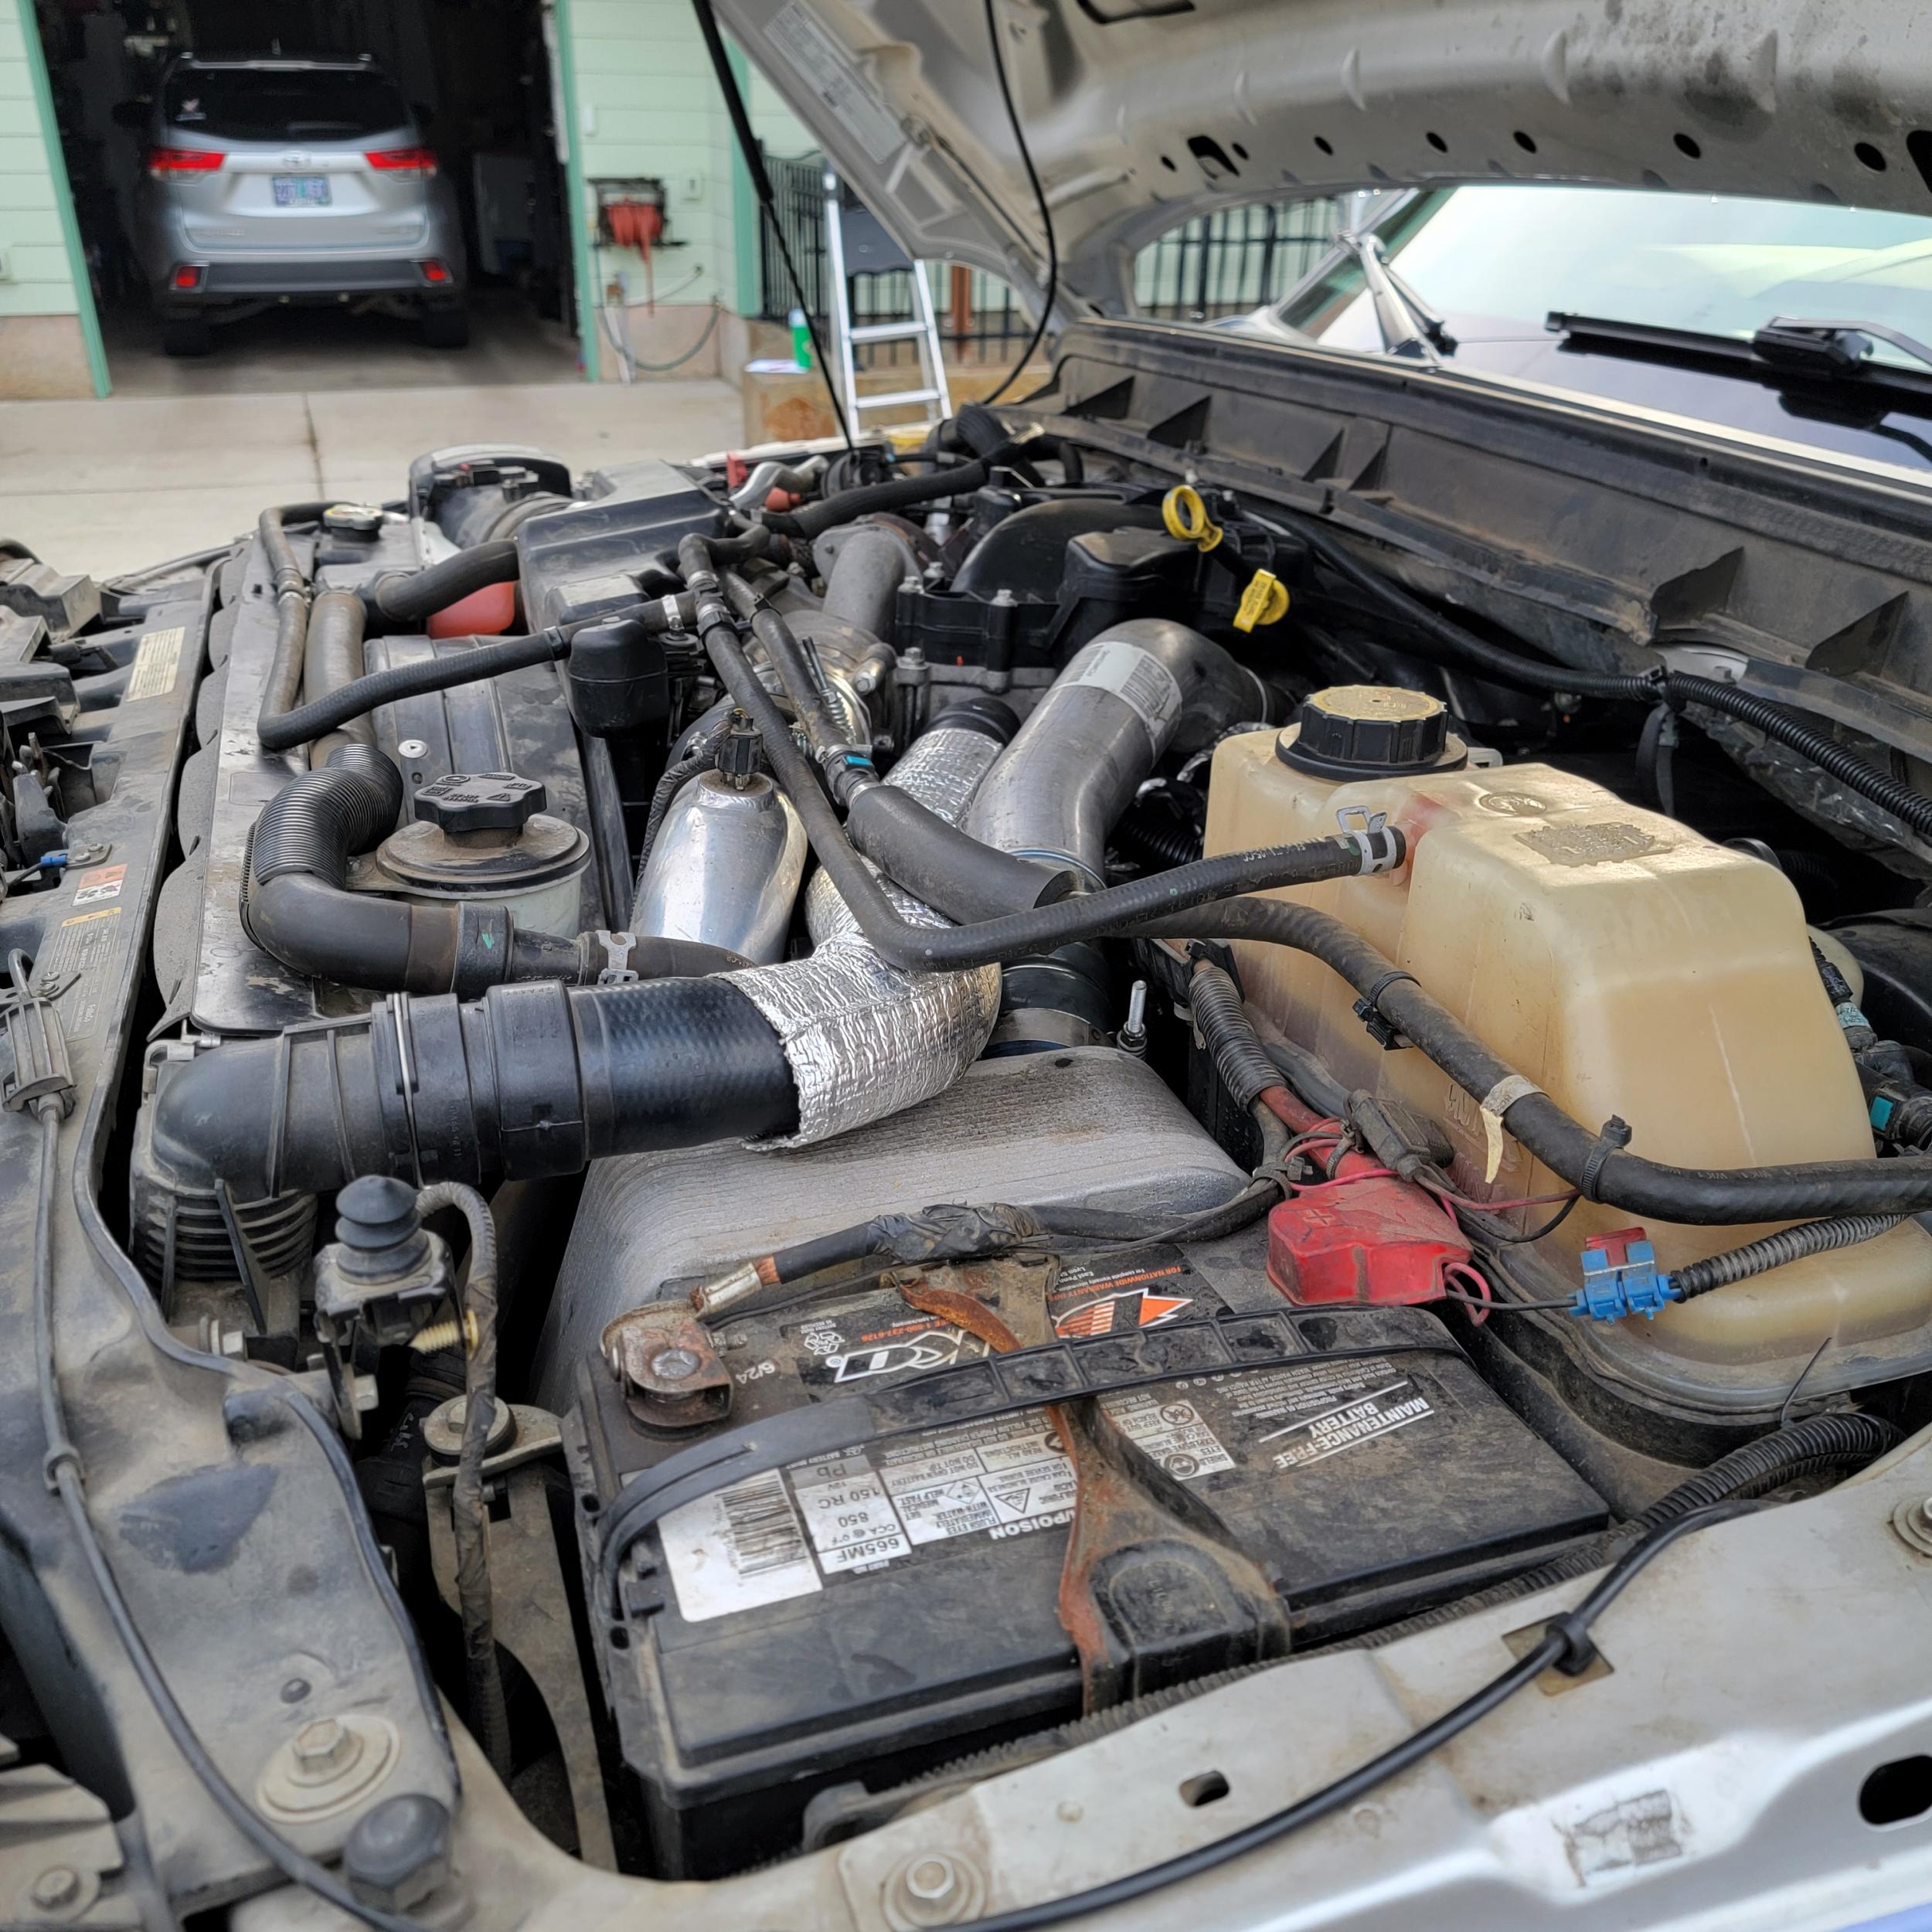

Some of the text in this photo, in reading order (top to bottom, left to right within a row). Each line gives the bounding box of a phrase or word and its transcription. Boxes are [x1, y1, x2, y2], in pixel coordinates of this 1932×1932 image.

[1165, 1266, 1181, 1274] FOR
[1059, 1275, 1077, 1284] Penn
[1115, 1270, 1165, 1285] NATIONWIDE
[1066, 1282, 1113, 1297] WARRANTY
[737, 1362, 775, 1385] 6/24
[1306, 1401, 1379, 1437] BATTERY
[1270, 1396, 1430, 1468] MAINTENANCE-FREE
[1022, 1447, 1042, 1456] READ
[944, 1458, 961, 1467] NOT
[951, 1464, 964, 1473] NOT
[816, 1462, 846, 1481] Pb
[926, 1468, 947, 1478] OPEN
[827, 1481, 845, 1490] 12V
[891, 1474, 925, 1486] BATTERY
[817, 1485, 880, 1509] 150 RC
[923, 1489, 944, 1499] HELP
[900, 1498, 938, 1513] MEDICAL
[965, 1502, 987, 1512] WITH
[837, 1511, 869, 1528] 850
[905, 1511, 920, 1519] GET
[935, 1509, 992, 1529] IMMEDIATELY
[869, 1522, 896, 1536] CCA
[946, 1517, 995, 1534] FLUSH EYES
[852, 1529, 866, 1539] @
[834, 1536, 900, 1563] 665MF
